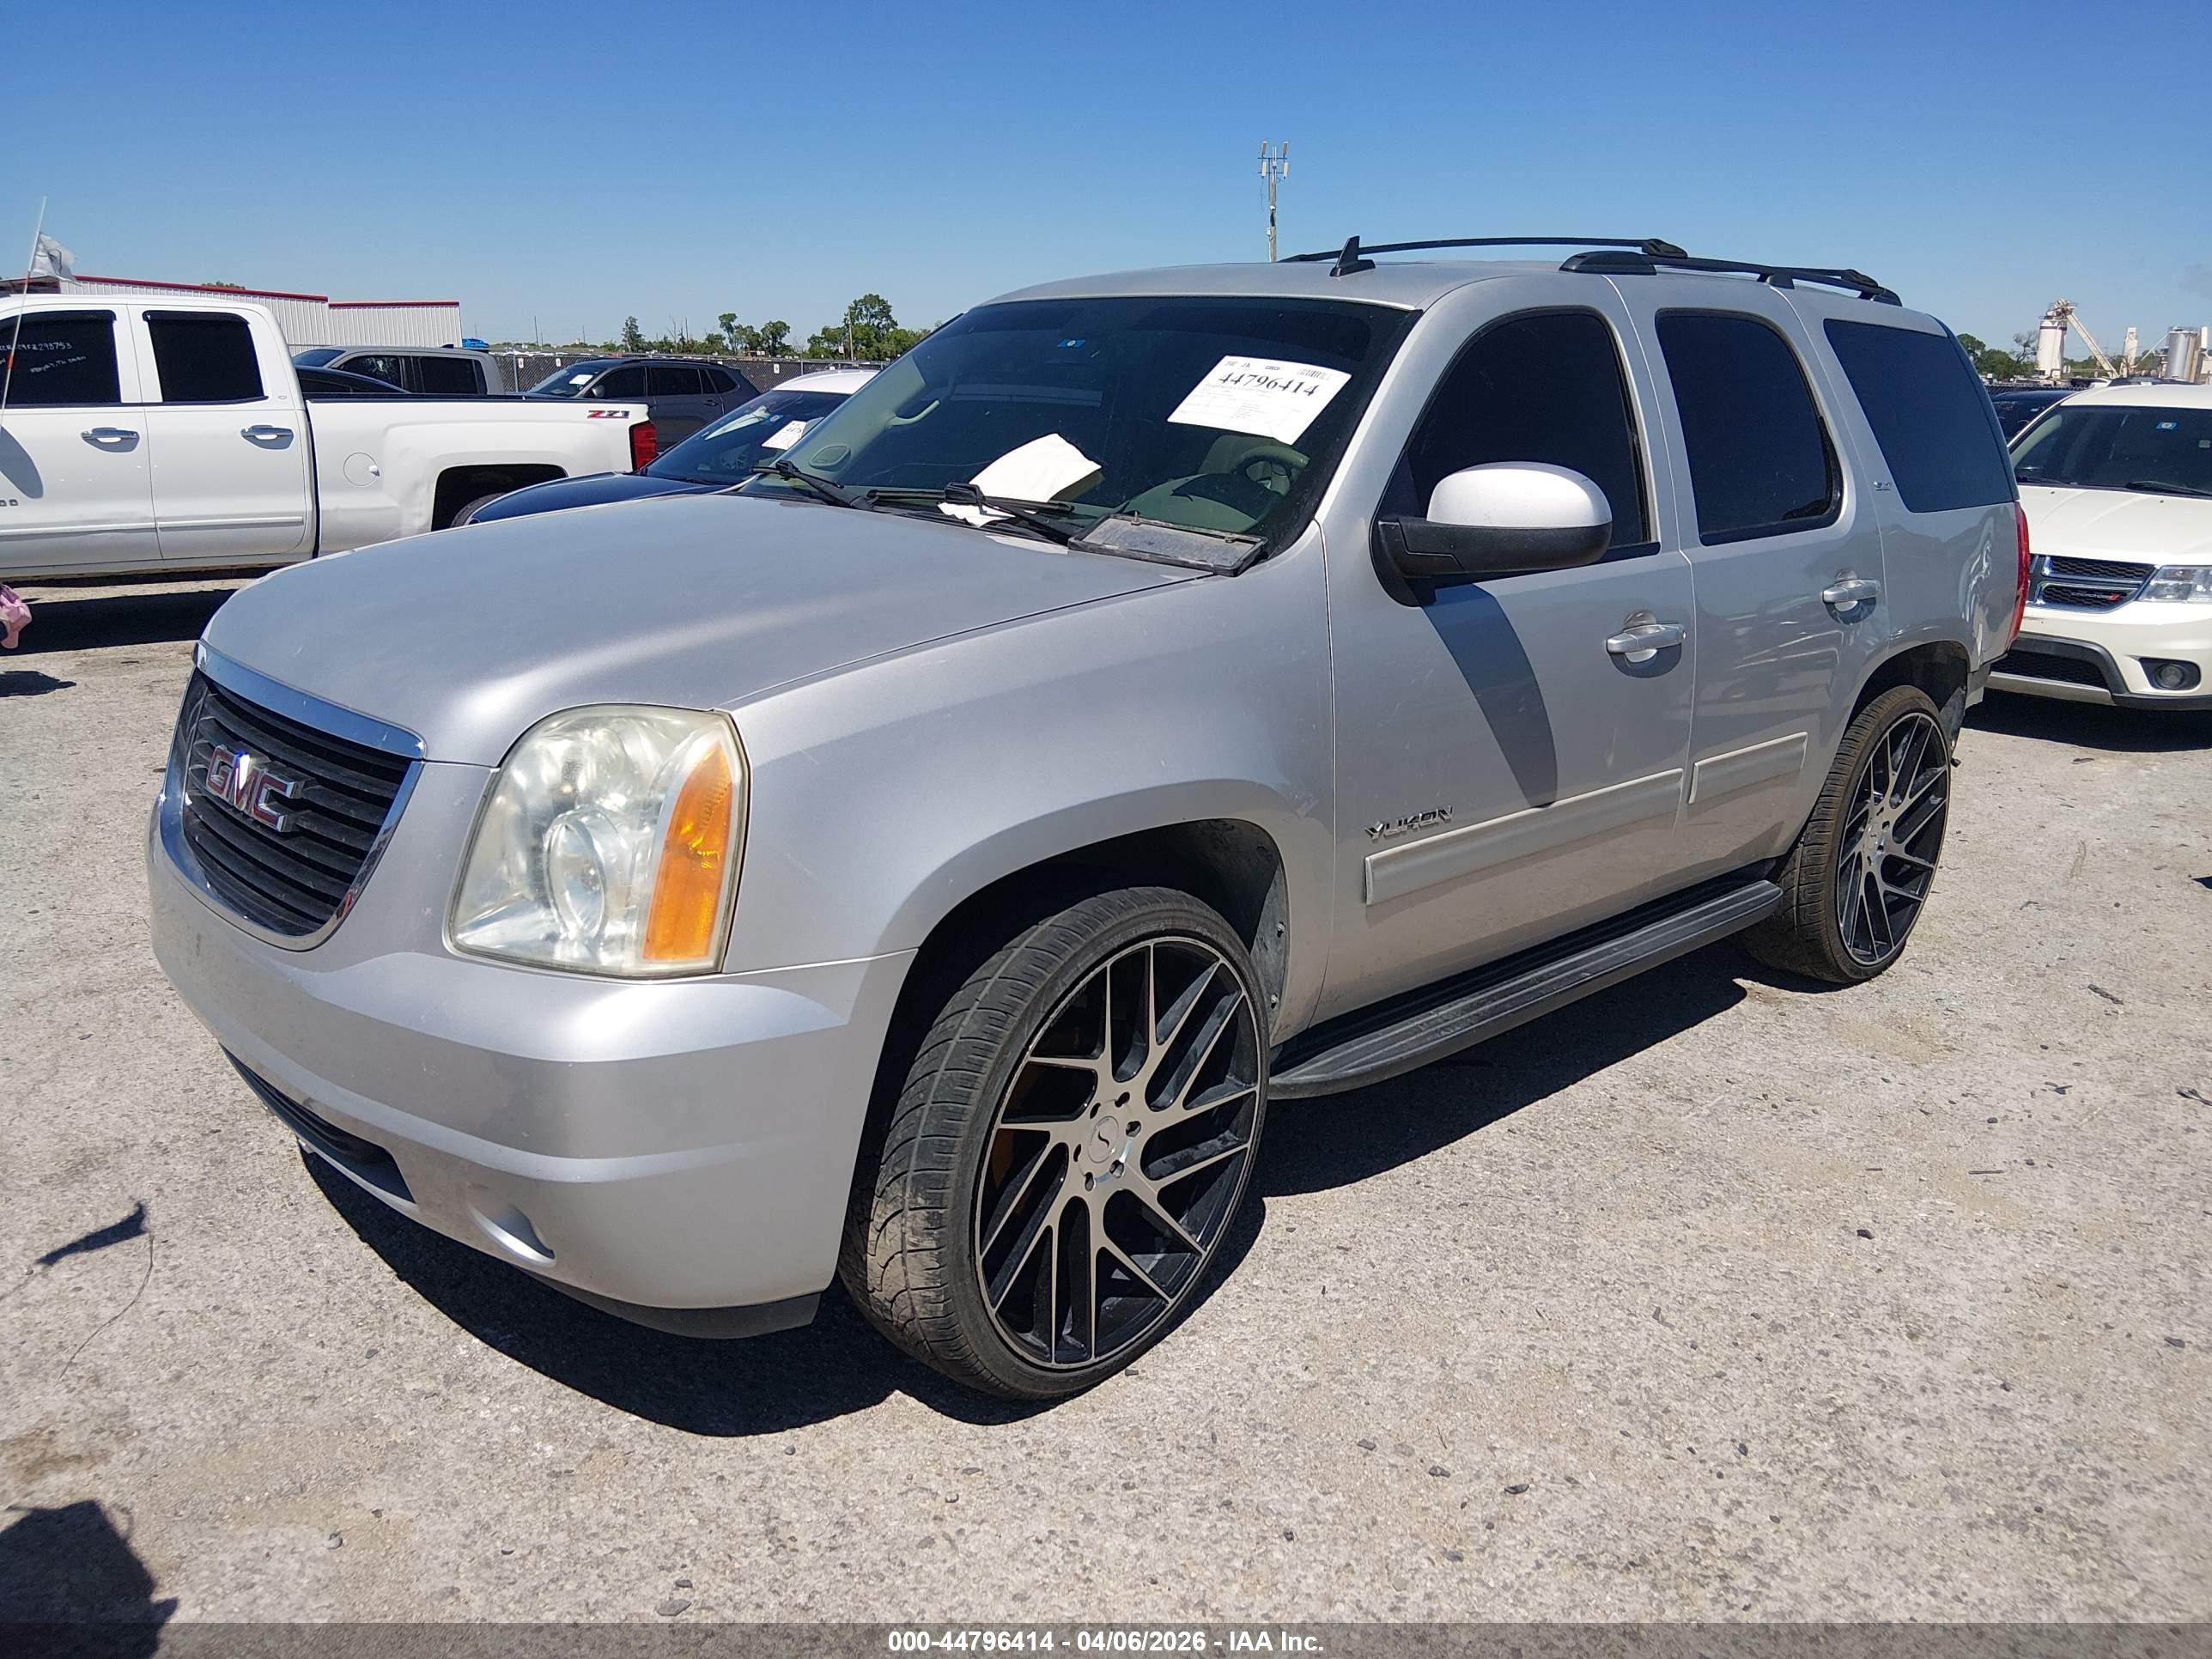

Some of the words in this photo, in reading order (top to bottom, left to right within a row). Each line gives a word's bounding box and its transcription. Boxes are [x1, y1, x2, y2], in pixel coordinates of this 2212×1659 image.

[1218, 372, 1320, 397] 44796414
[587, 410, 630, 419] Z71
[206, 744, 301, 833] GMC
[1364, 805, 1455, 842] YUKON
